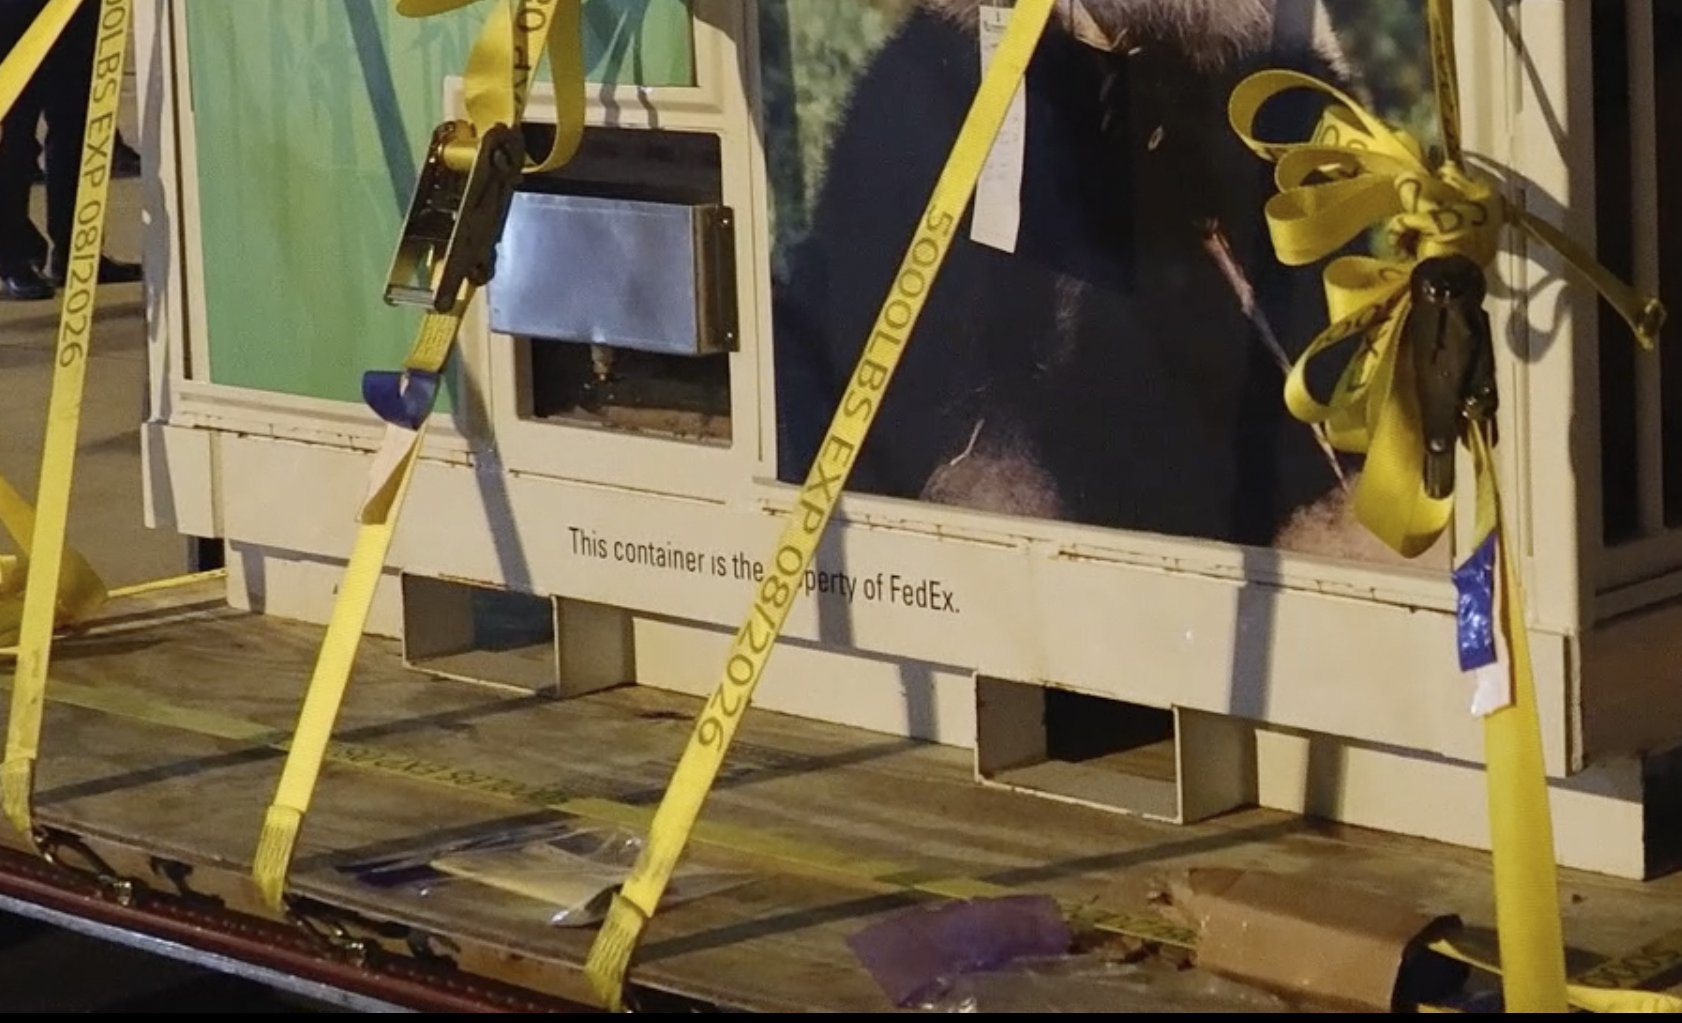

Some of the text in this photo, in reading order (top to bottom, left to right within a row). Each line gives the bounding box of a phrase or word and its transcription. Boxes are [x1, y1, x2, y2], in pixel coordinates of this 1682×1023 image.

[82, 115, 117, 190] EXP
[59, 199, 102, 369] 08/2026
[696, 204, 955, 749] 5000LBS EXP 08/2026
[568, 527, 961, 615] This container is the perty of FedEx.
